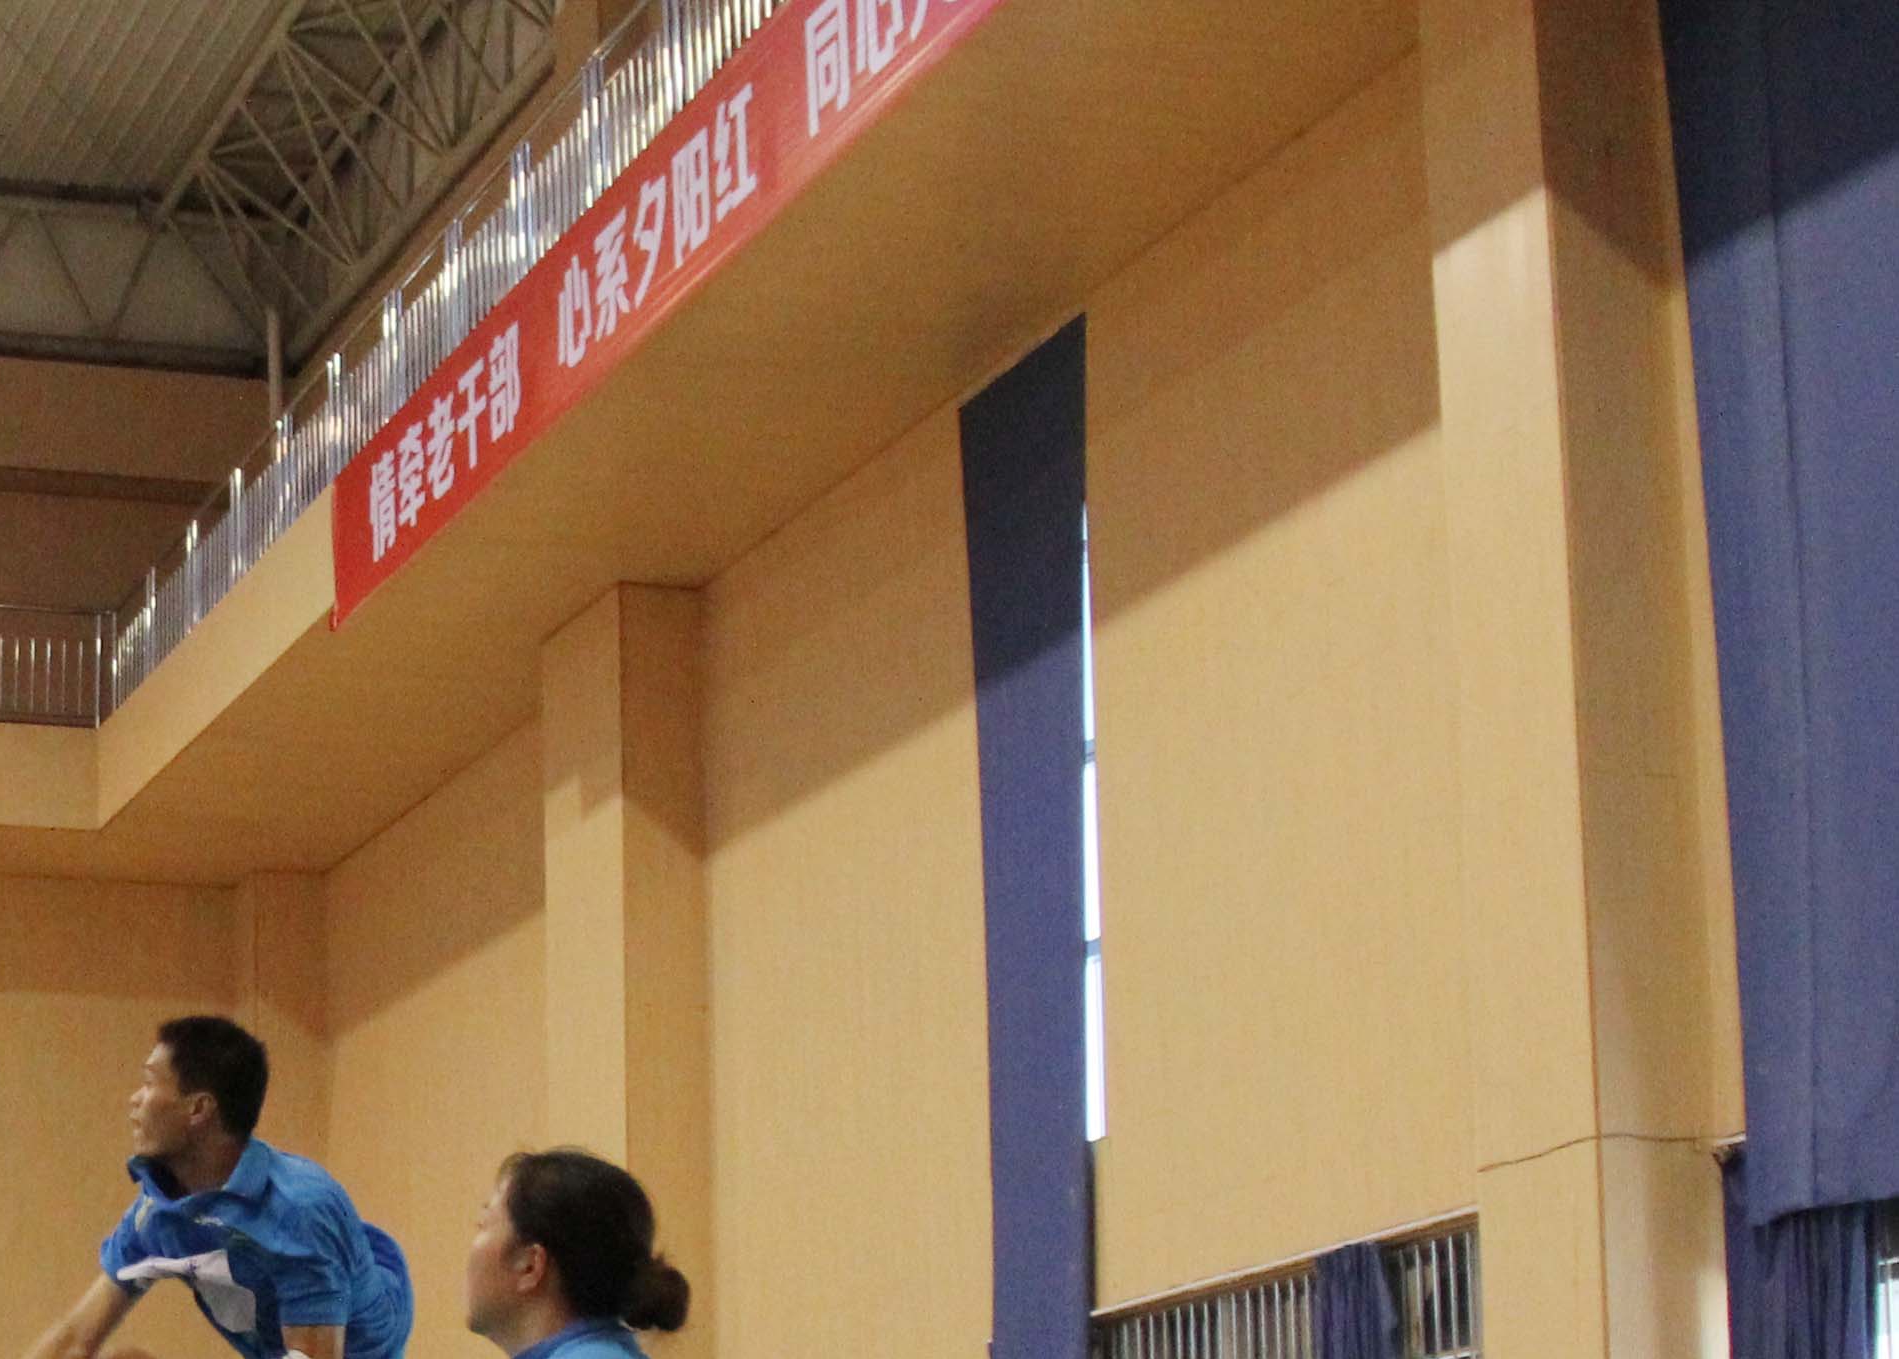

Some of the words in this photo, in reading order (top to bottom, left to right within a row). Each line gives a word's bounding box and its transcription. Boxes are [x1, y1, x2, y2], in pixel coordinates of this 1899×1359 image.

[369, 321, 521, 563] 情牵老干部
[557, 83, 758, 368] 心系夕阳红
[805, 0, 953, 139] 同心
